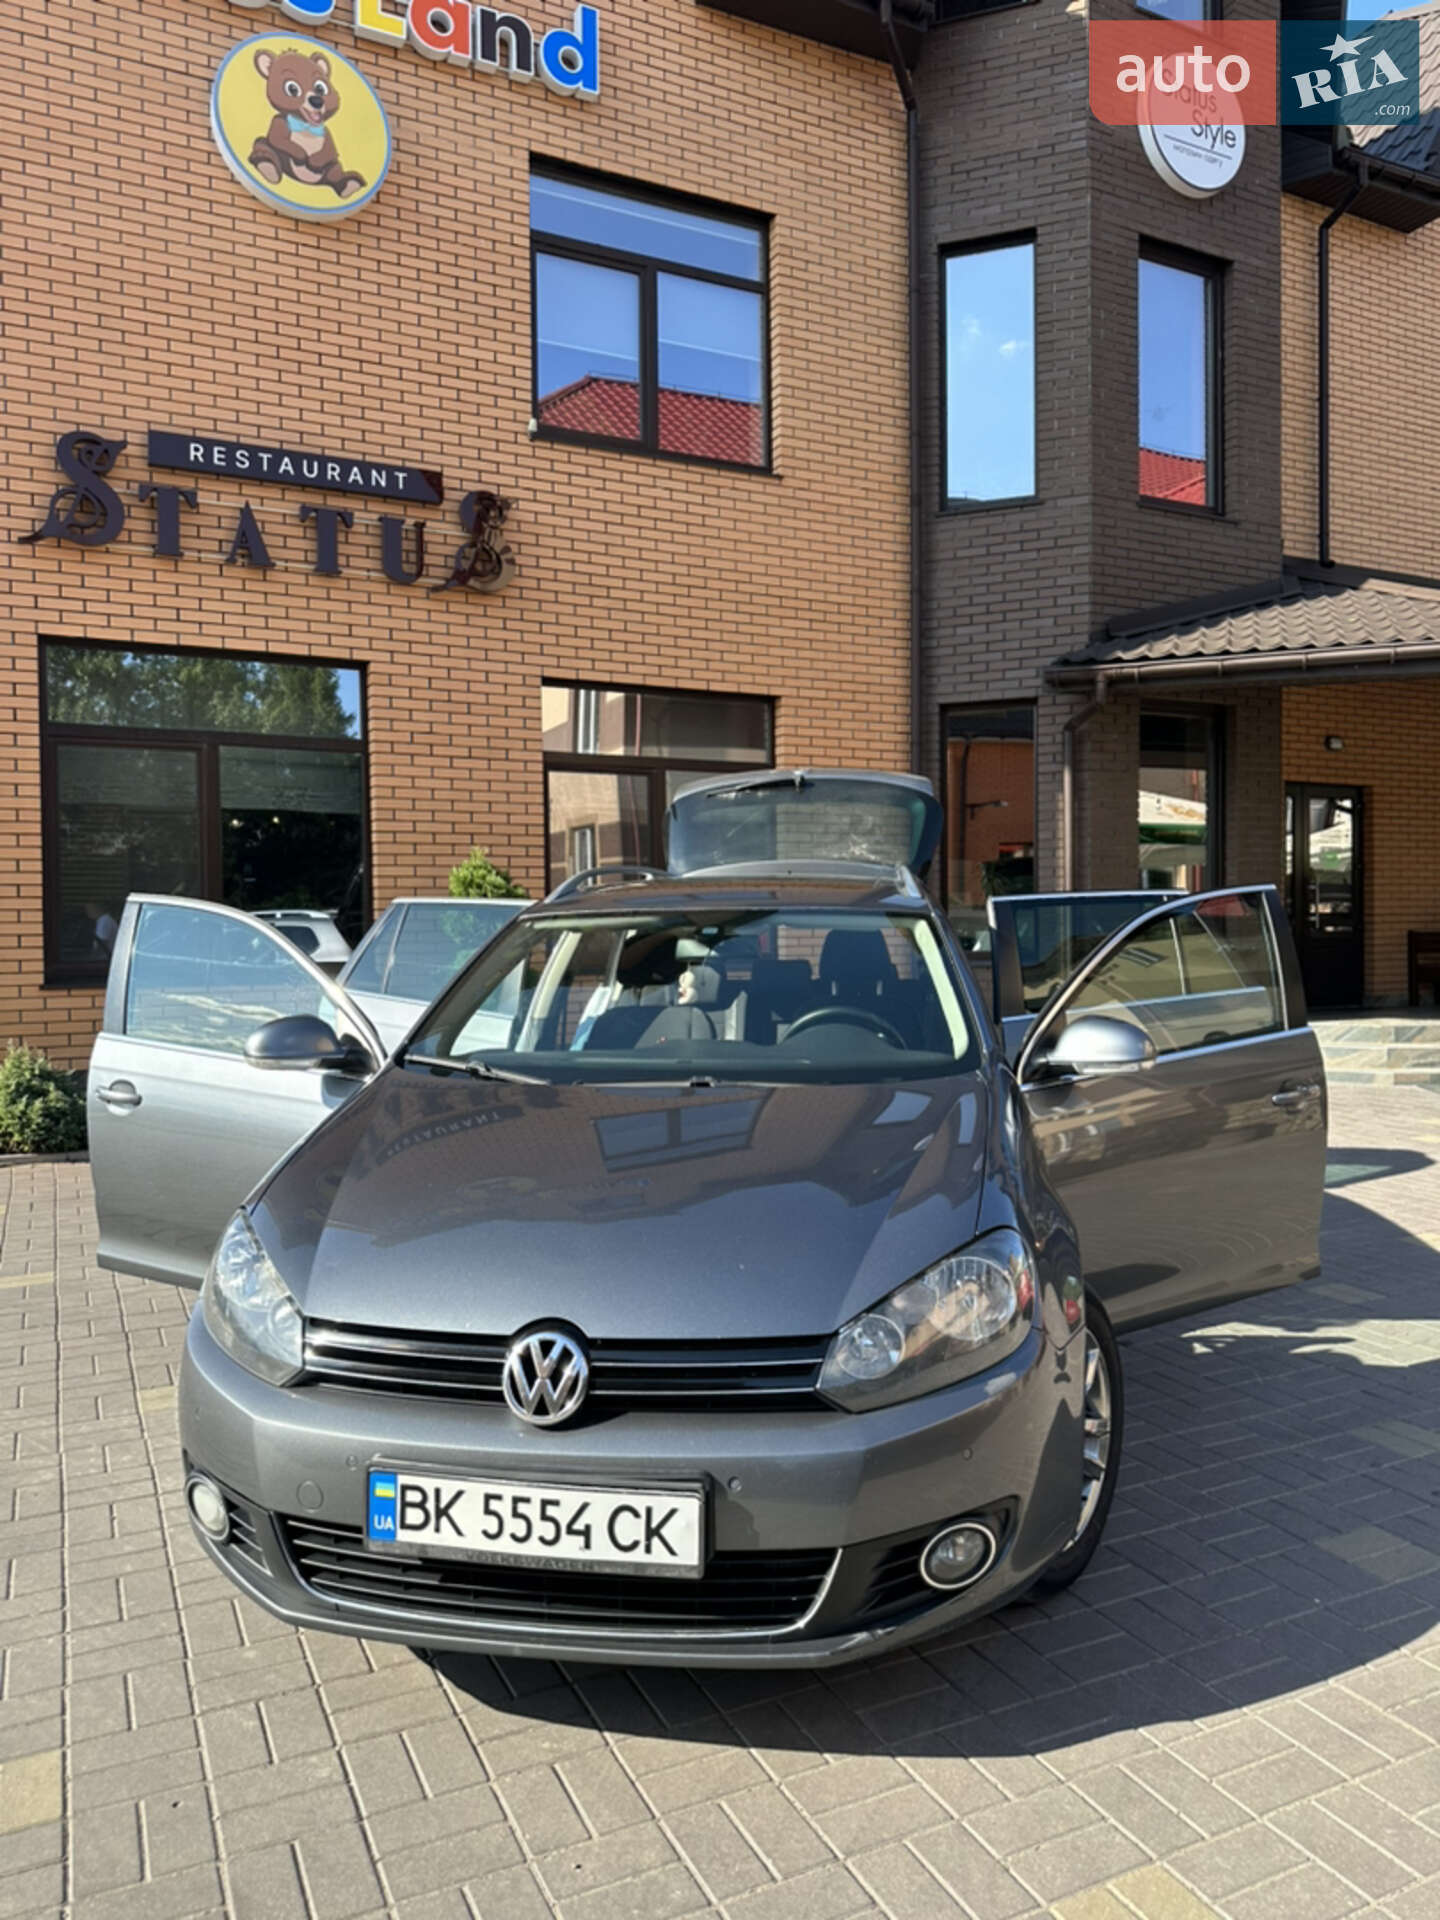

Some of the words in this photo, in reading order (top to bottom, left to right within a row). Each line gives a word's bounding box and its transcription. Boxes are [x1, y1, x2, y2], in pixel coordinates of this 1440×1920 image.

[1191, 109, 1237, 149] Style
[188, 442, 410, 491] RESTAURANT
[373, 1515, 395, 1532] UA
[399, 1483, 466, 1537] BK
[481, 1492, 592, 1550] 5554
[606, 1503, 679, 1557] CK
